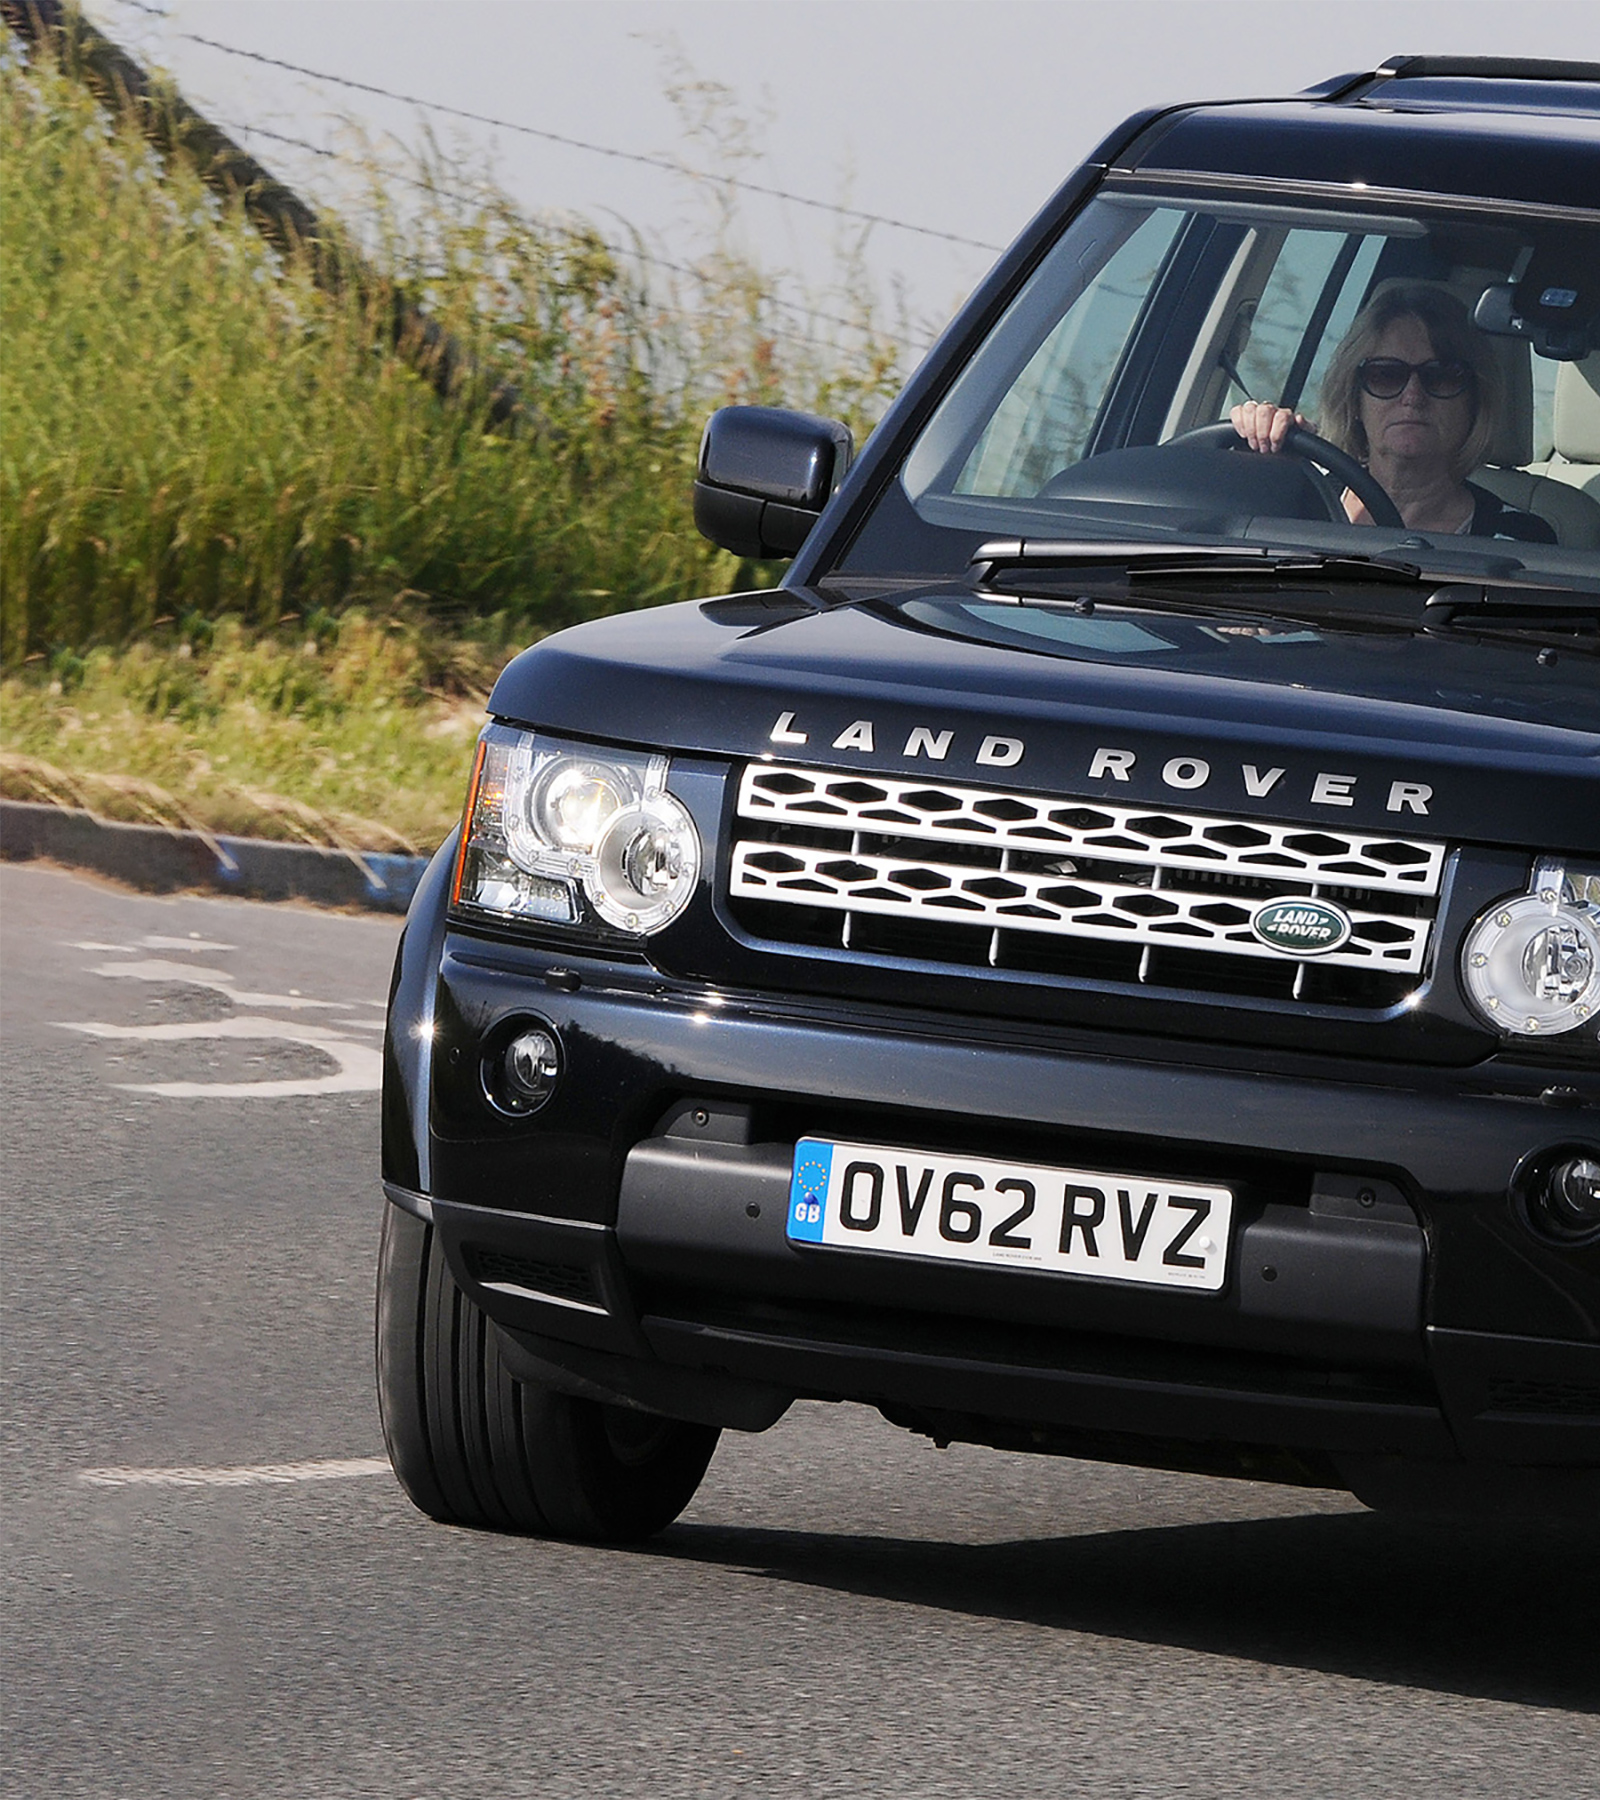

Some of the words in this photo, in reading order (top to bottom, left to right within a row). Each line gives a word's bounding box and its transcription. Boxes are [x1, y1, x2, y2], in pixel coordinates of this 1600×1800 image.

[770, 711, 1025, 767] LAND
[1088, 747, 1433, 815] ROVER
[1273, 909, 1319, 925] LAND
[1275, 923, 1332, 941] ROVER
[795, 1202, 820, 1223] GB
[839, 1160, 1036, 1249] OV62
[1058, 1183, 1212, 1269] RVZ
